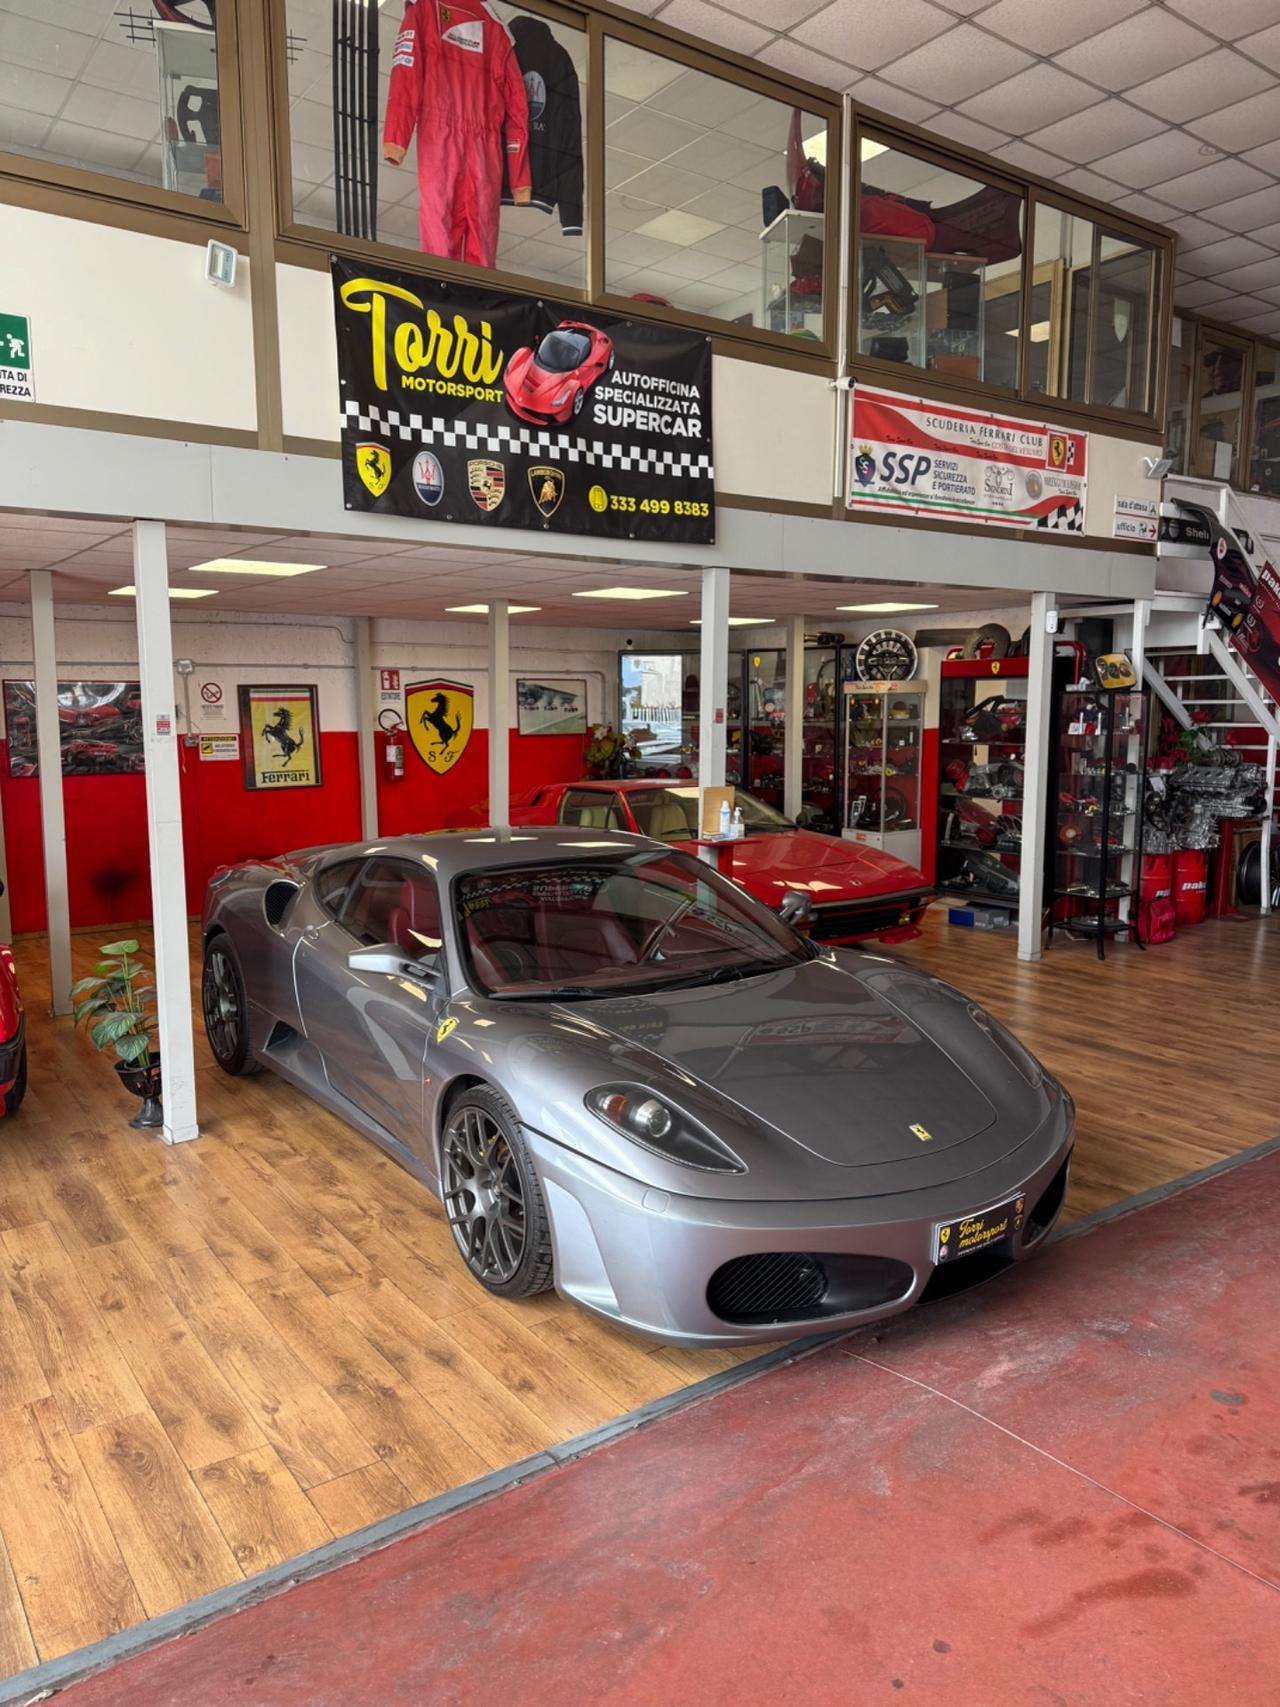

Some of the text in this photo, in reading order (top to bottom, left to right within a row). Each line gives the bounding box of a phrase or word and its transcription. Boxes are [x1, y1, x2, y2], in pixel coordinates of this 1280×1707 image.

[340, 278, 503, 391] Torri
[17, 372, 28, 382] DI
[401, 375, 504, 403] MOTORSPORT
[611, 370, 700, 398] AUTOFFICINA
[594, 386, 701, 415] SPECIALIZZATA
[593, 404, 702, 438] SUPERCAR
[926, 416, 976, 435] SCUDERIA
[979, 426, 1016, 443] FERRARI
[1020, 434, 1044, 447] CLUB
[880, 451, 932, 486] SSP
[933, 459, 958, 471] SERVIZI
[933, 470, 968, 484] SICUREZZA
[932, 481, 937, 490] E
[938, 482, 976, 496] PORTIERATO
[610, 495, 709, 518] 333 499 8383
[261, 769, 310, 784] Ferrari
[957, 1218, 1008, 1249] motorsport
[959, 1218, 985, 1238] Torri
